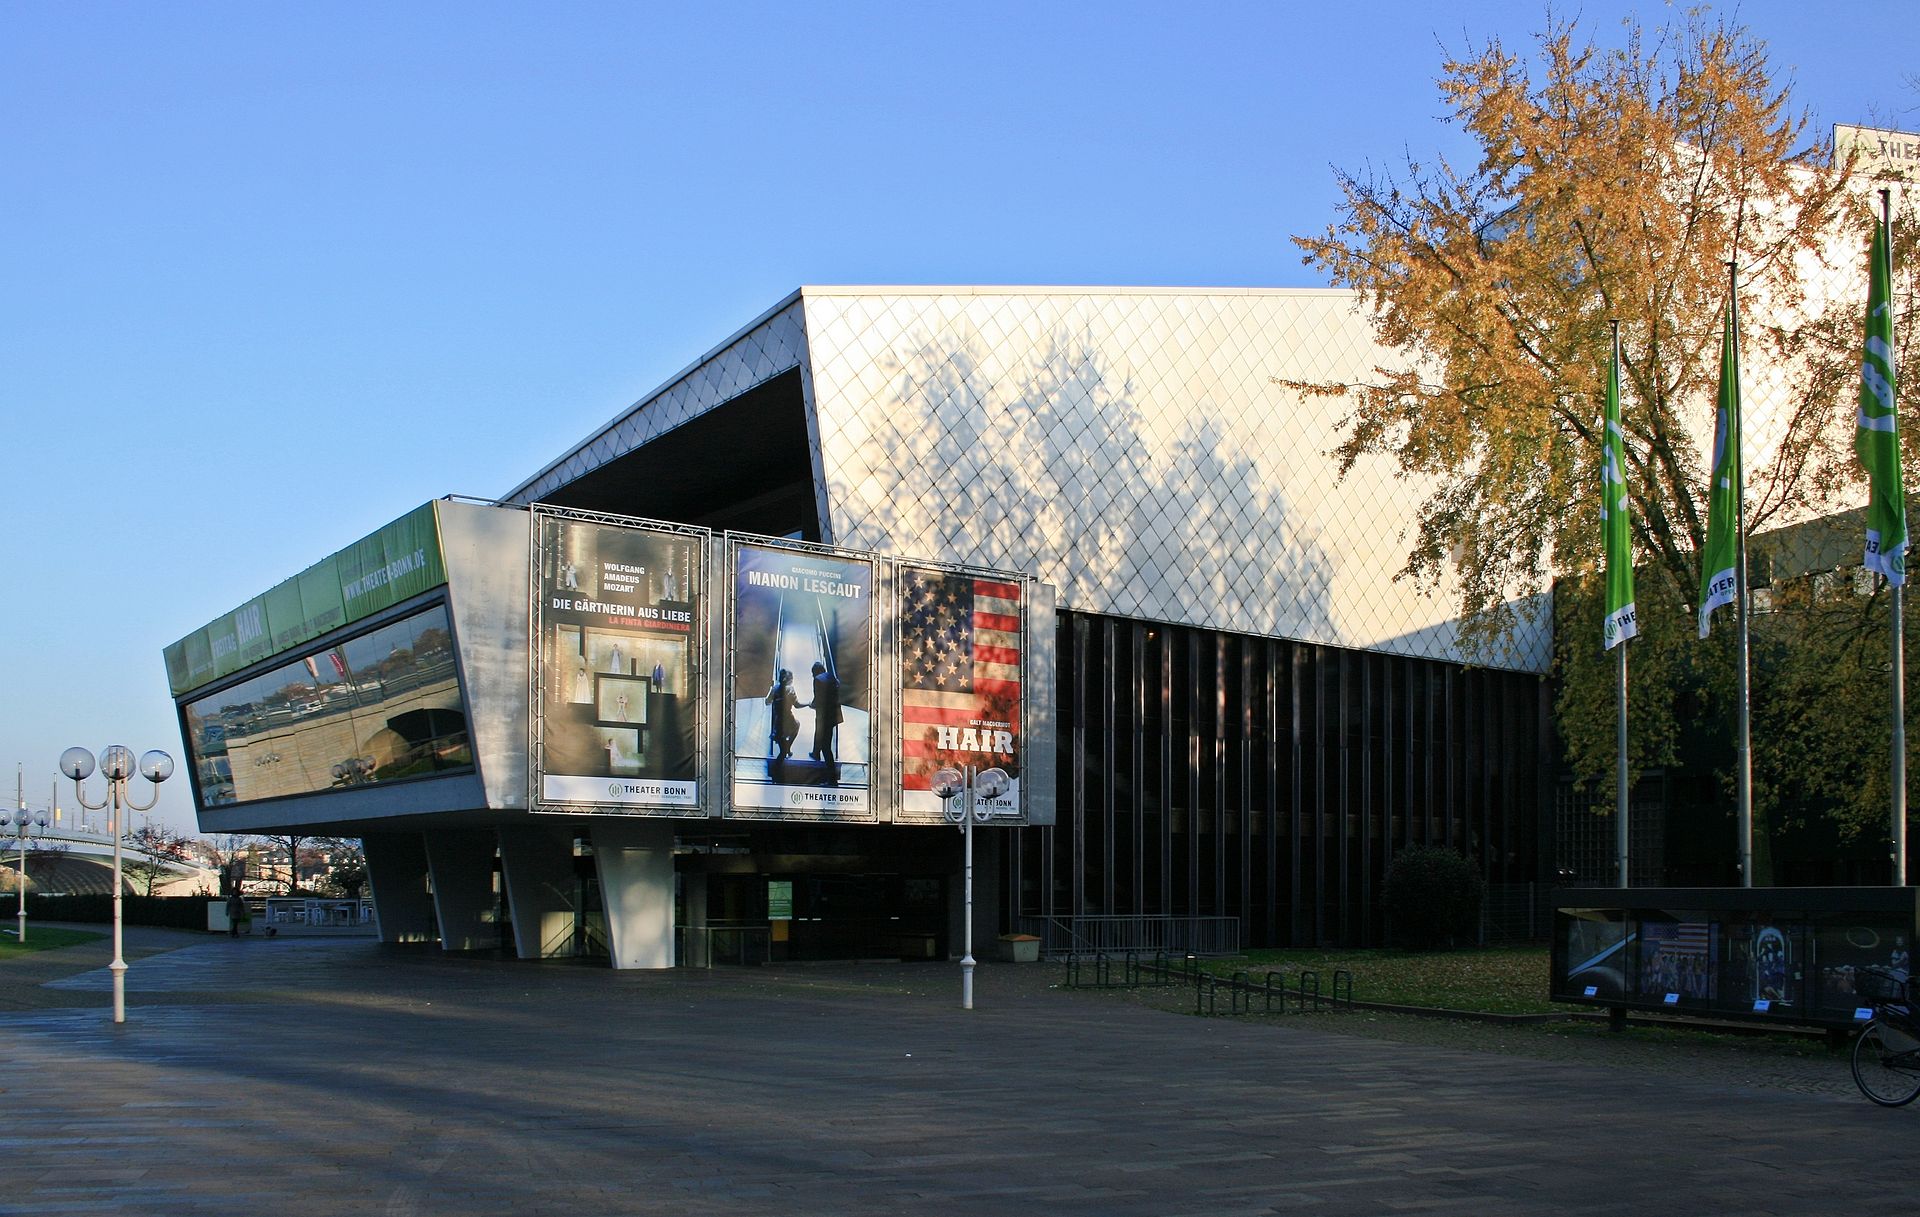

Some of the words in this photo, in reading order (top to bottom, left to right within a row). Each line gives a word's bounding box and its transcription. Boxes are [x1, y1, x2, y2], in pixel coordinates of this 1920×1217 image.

[604, 562, 645, 575] WOLFGANG
[791, 567, 818, 576] GIACOMO
[819, 571, 841, 579] PUCCINI
[604, 573, 640, 584] AMADEUS
[749, 571, 799, 591] MANON
[803, 578, 862, 599] LESCAUT
[604, 583, 635, 593] MOZART
[553, 598, 571, 610] DIE
[574, 598, 635, 616] GÄRTNERIN
[638, 607, 659, 619] AUS
[662, 609, 691, 622] LIEBE
[235, 604, 263, 645] HAIR
[608, 616, 619, 624] LA
[620, 617, 642, 627] FINTA
[643, 620, 690, 631] GIARDINIERA
[937, 726, 1014, 754] HAIR
[624, 785, 661, 794] THEATER
[664, 787, 686, 795] BONN
[805, 793, 837, 802] THEATER
[839, 794, 859, 802] BONN
